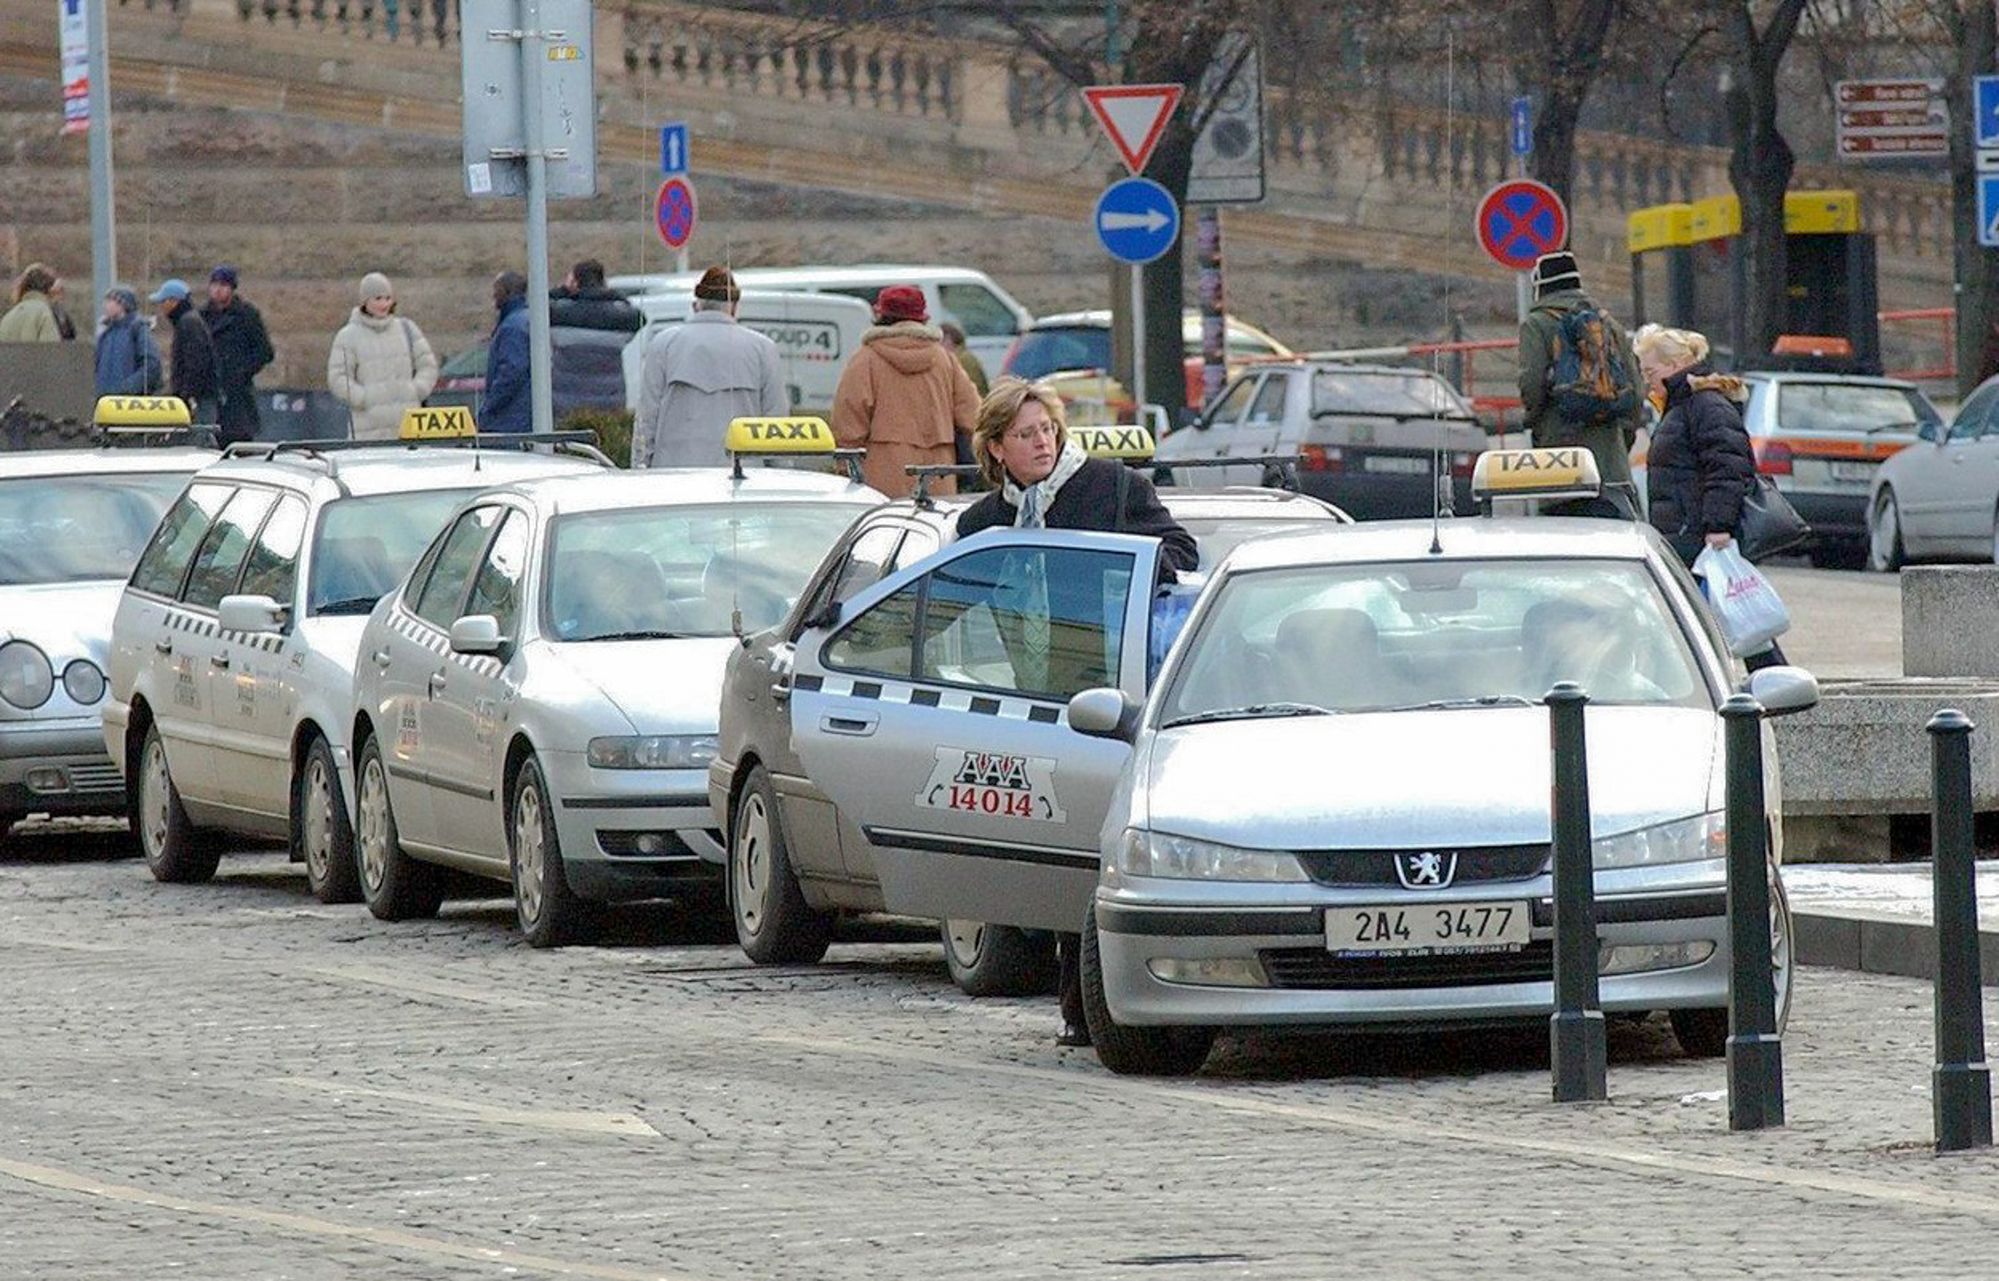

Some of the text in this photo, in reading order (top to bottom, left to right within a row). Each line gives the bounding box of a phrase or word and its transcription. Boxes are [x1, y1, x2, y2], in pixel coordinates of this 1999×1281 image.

[815, 331, 830, 349] 4
[109, 398, 177, 411] TAXI
[411, 412, 464, 431] TAXI
[743, 423, 820, 440] TAXI
[1072, 429, 1145, 450] TAXI
[1493, 451, 1579, 471] TAXI
[954, 751, 1031, 790] AAA
[1355, 907, 1513, 942] 2A4 3477
